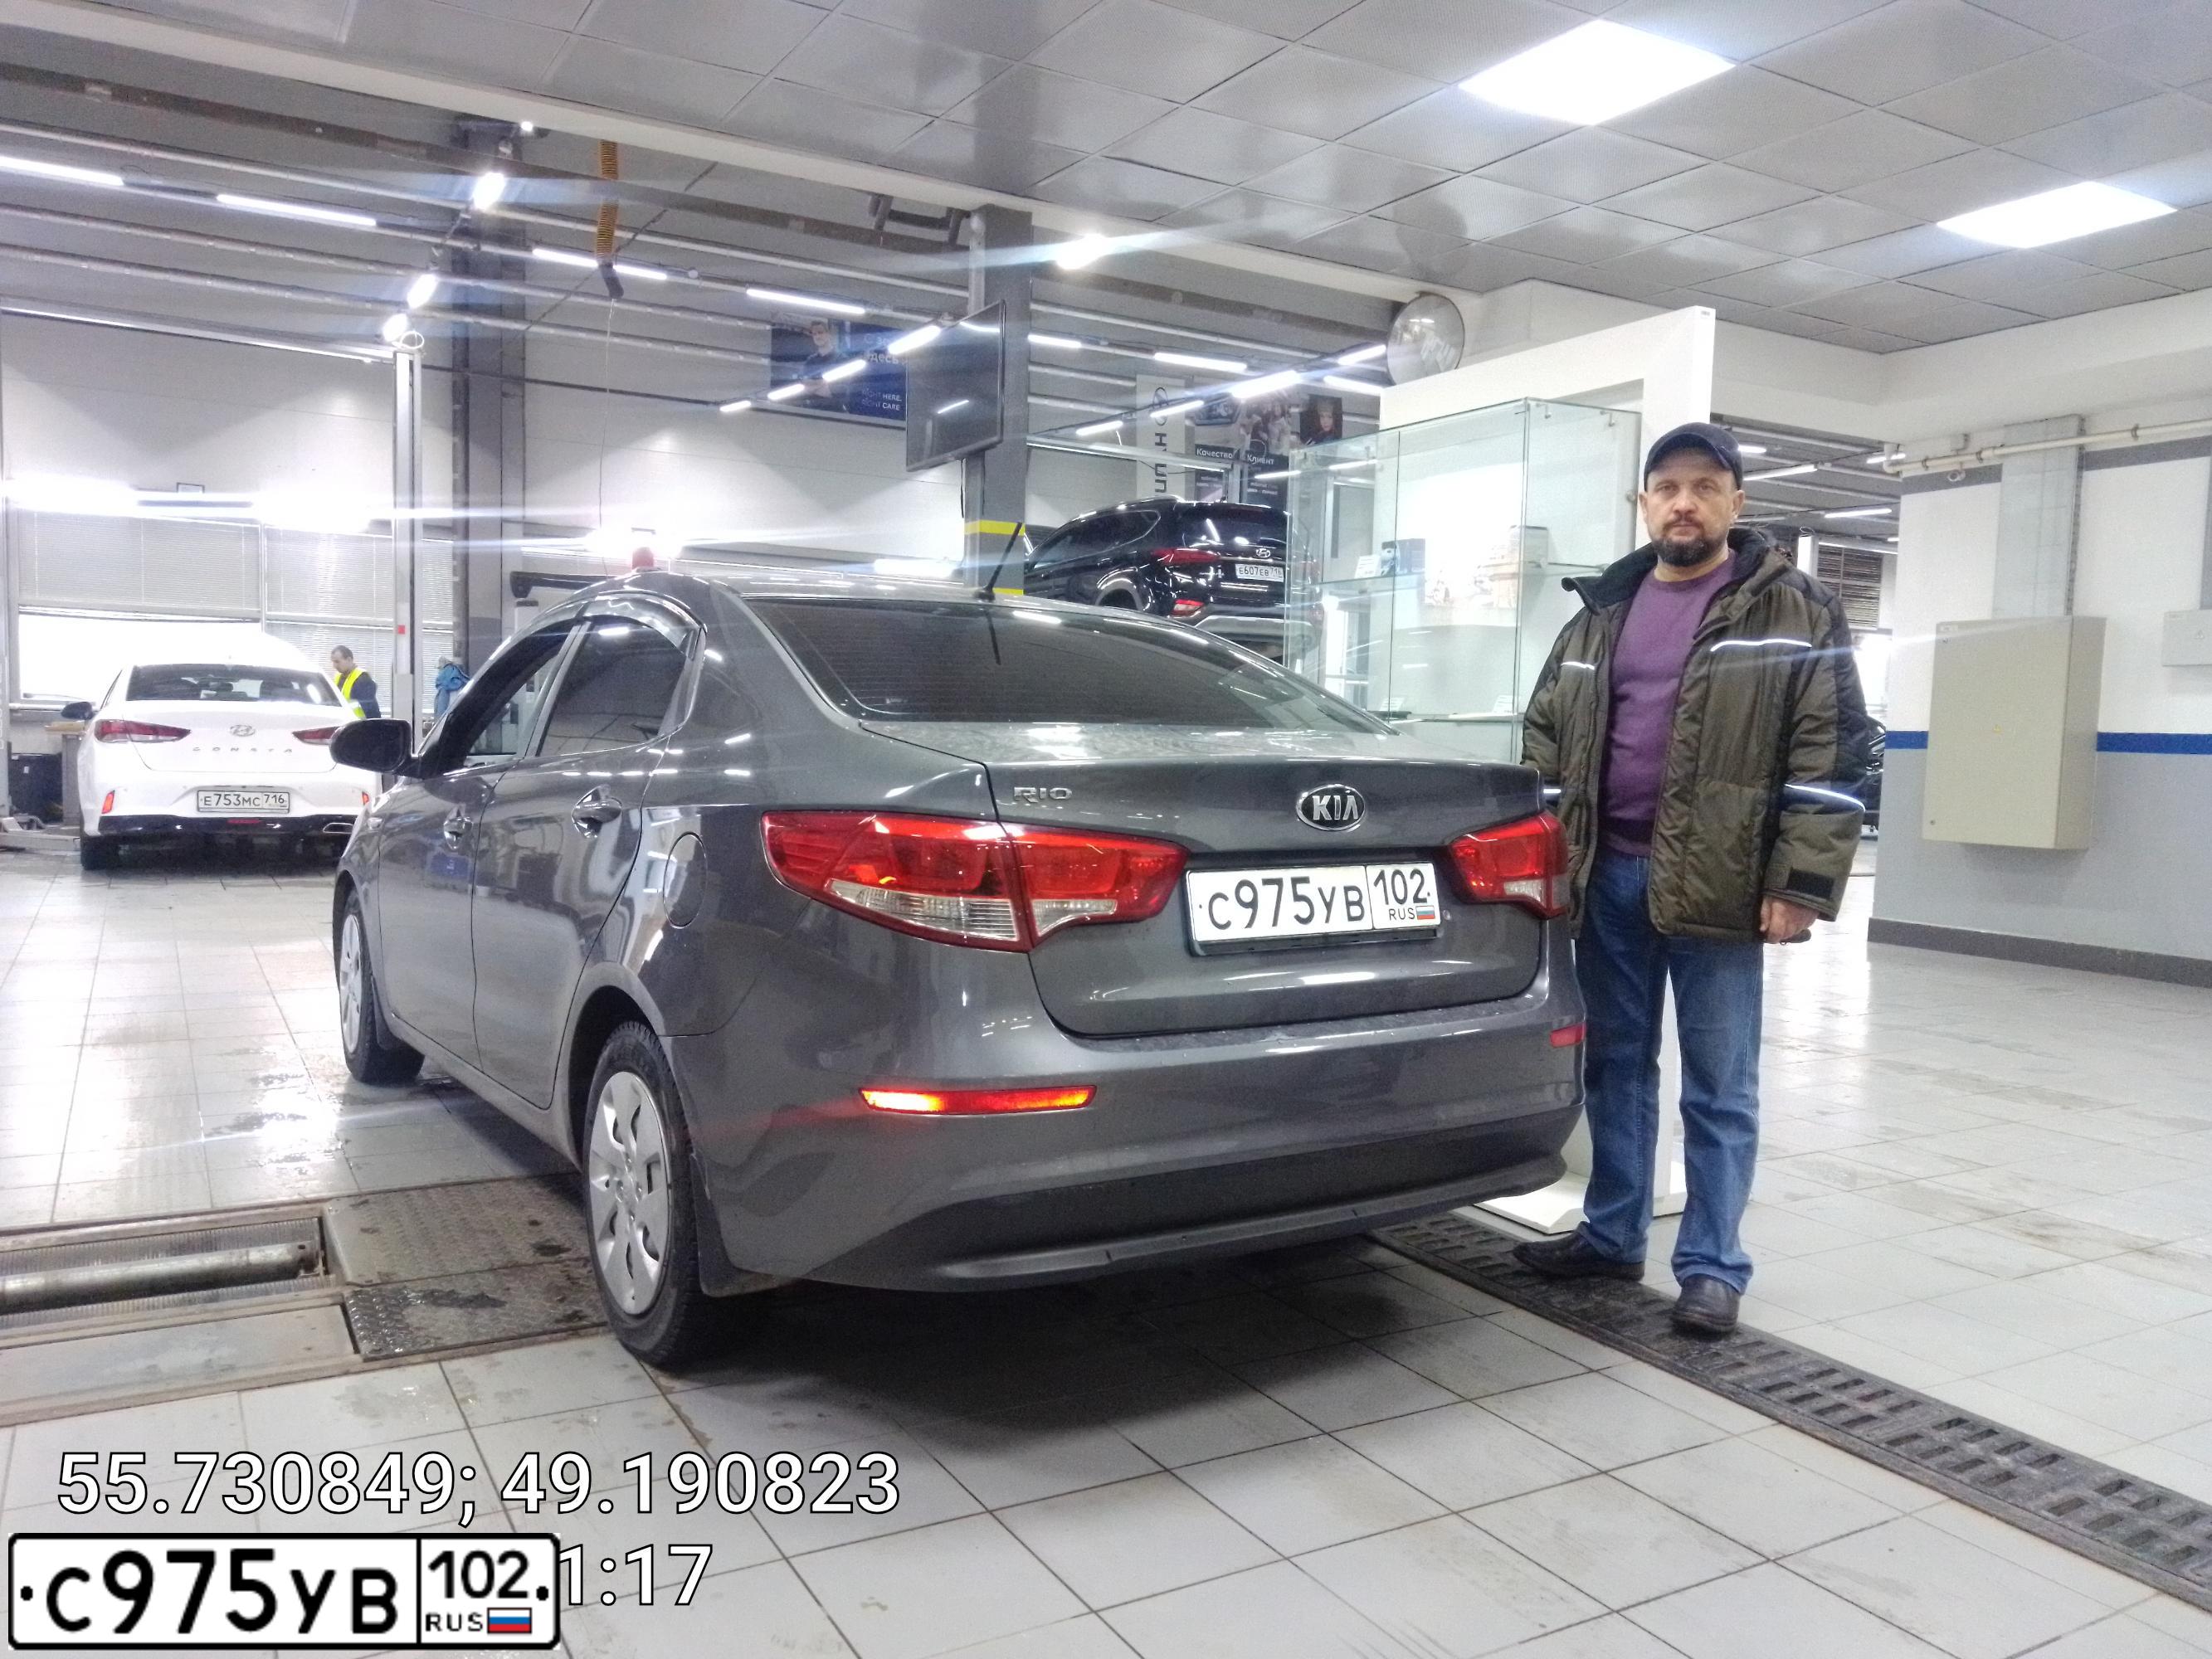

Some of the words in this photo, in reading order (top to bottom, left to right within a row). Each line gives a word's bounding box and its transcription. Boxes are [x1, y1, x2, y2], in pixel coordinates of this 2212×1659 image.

[1196, 448, 1233, 459] Качество
[1247, 454, 1274, 465] Клиент
[264, 794, 285, 804] 716
[1014, 786, 1073, 803] RIO
[1312, 795, 1359, 820] KIA
[1373, 868, 1427, 905] 102
[1388, 907, 1415, 921] RUS
